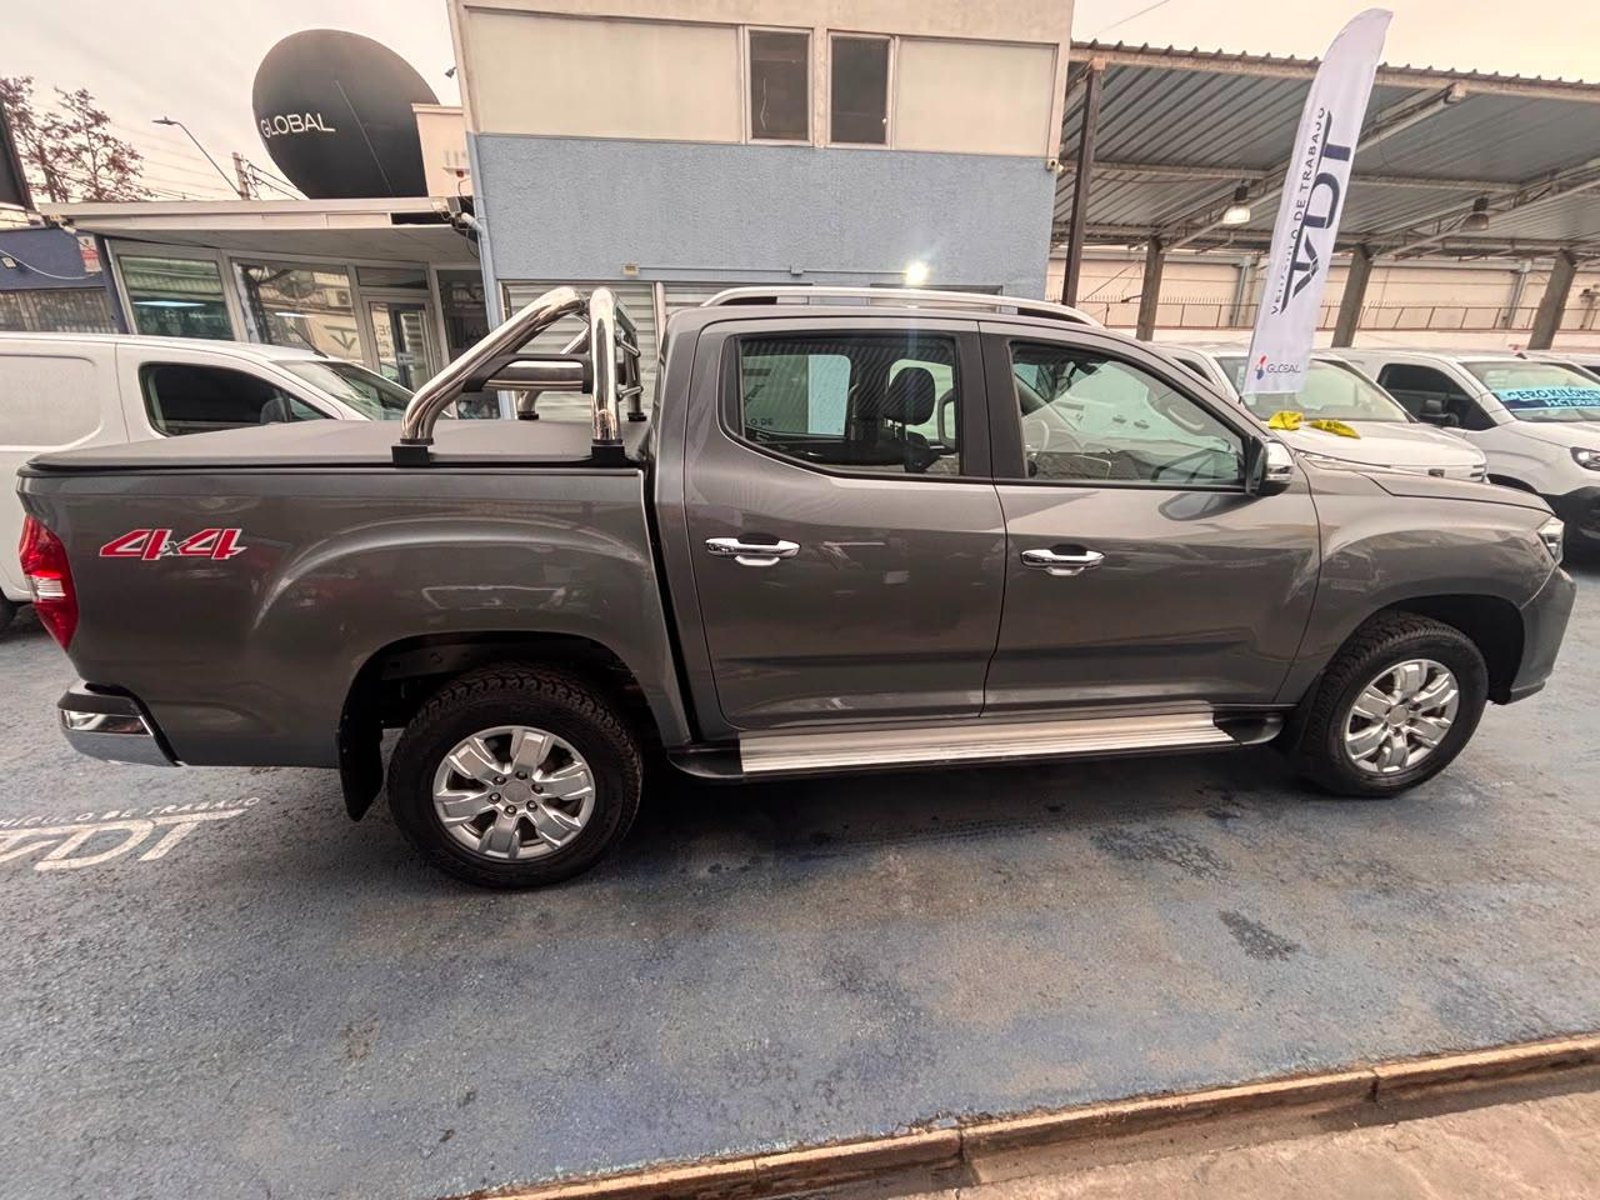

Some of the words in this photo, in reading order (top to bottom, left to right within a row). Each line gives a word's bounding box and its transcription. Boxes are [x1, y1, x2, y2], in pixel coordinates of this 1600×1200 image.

[260, 112, 336, 138] GLOBAL
[1294, 200, 1306, 221] DE
[1301, 107, 1325, 191] TRABAJO
[99, 528, 248, 561] 4x4
